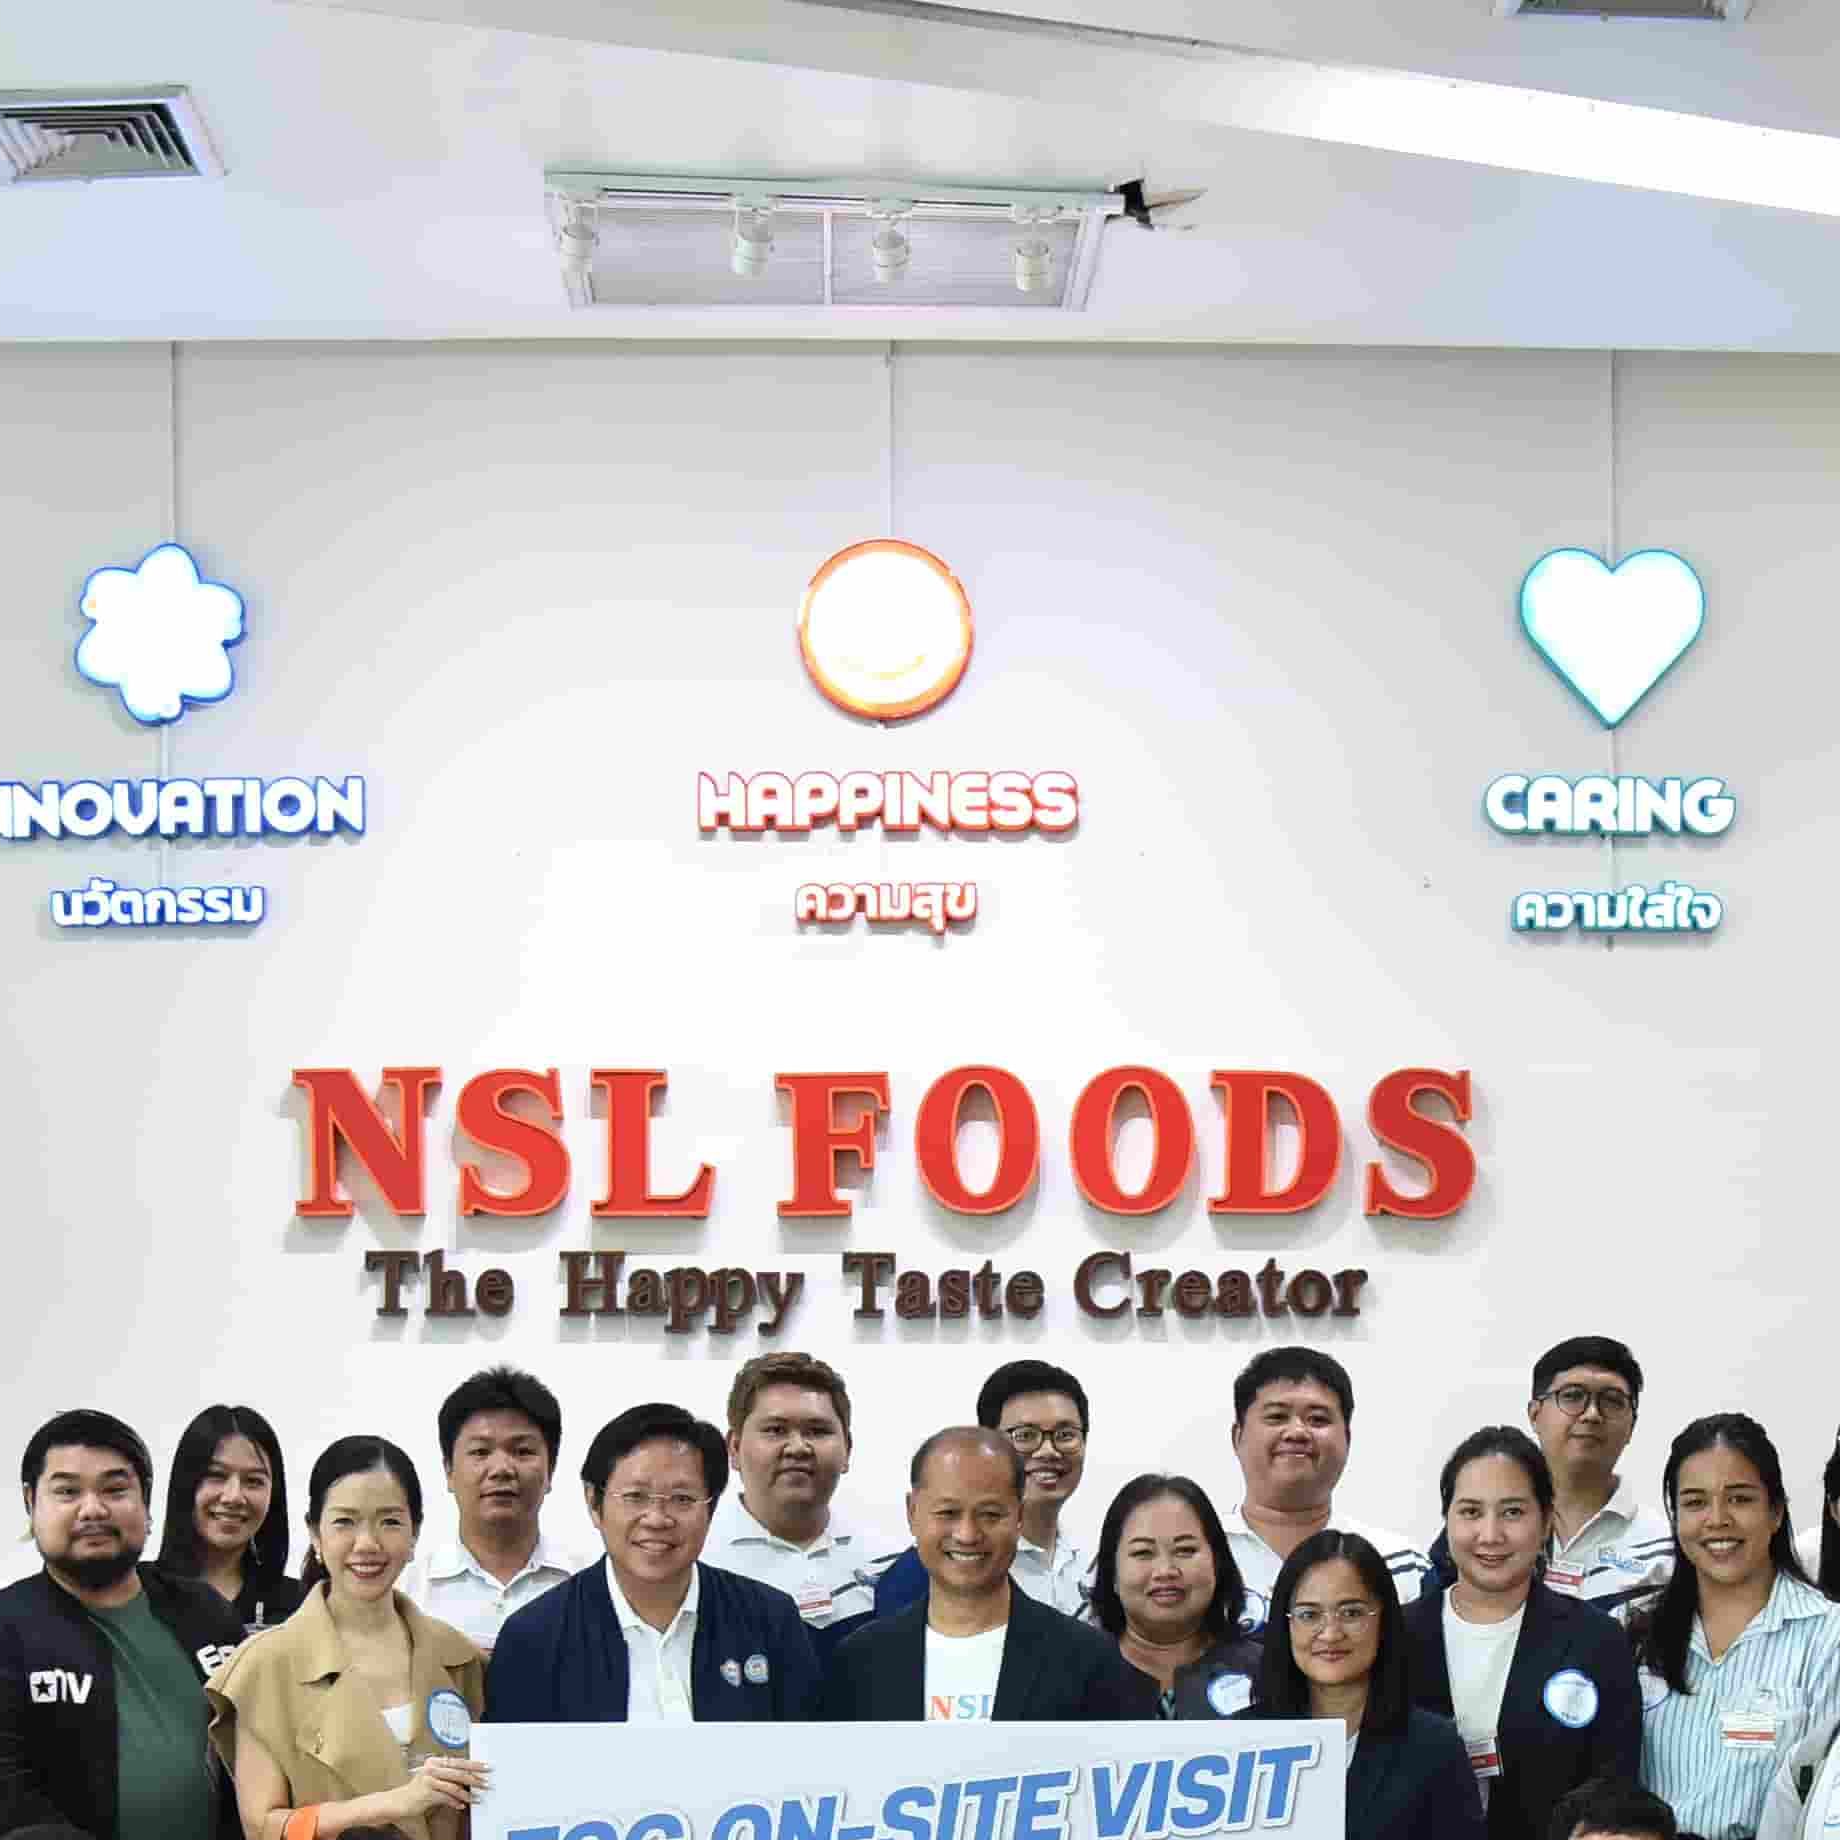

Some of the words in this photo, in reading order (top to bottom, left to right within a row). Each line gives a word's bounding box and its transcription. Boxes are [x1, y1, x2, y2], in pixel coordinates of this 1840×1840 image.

[697, 771, 1079, 832] HAPPINESS
[1485, 774, 1737, 836] CARING
[50, 877, 264, 927] นวัตกรรม
[794, 882, 978, 936] ความสุข
[1513, 880, 1723, 931] ความใส่ใจ
[291, 1066, 716, 1218] NSL
[774, 1064, 1477, 1219] FOODS
[365, 1249, 514, 1317] The
[560, 1250, 805, 1338] Happy
[842, 1250, 1046, 1321] Taste
[1072, 1250, 1368, 1320] Creator
[1091, 1743, 1315, 1839] VISIT
